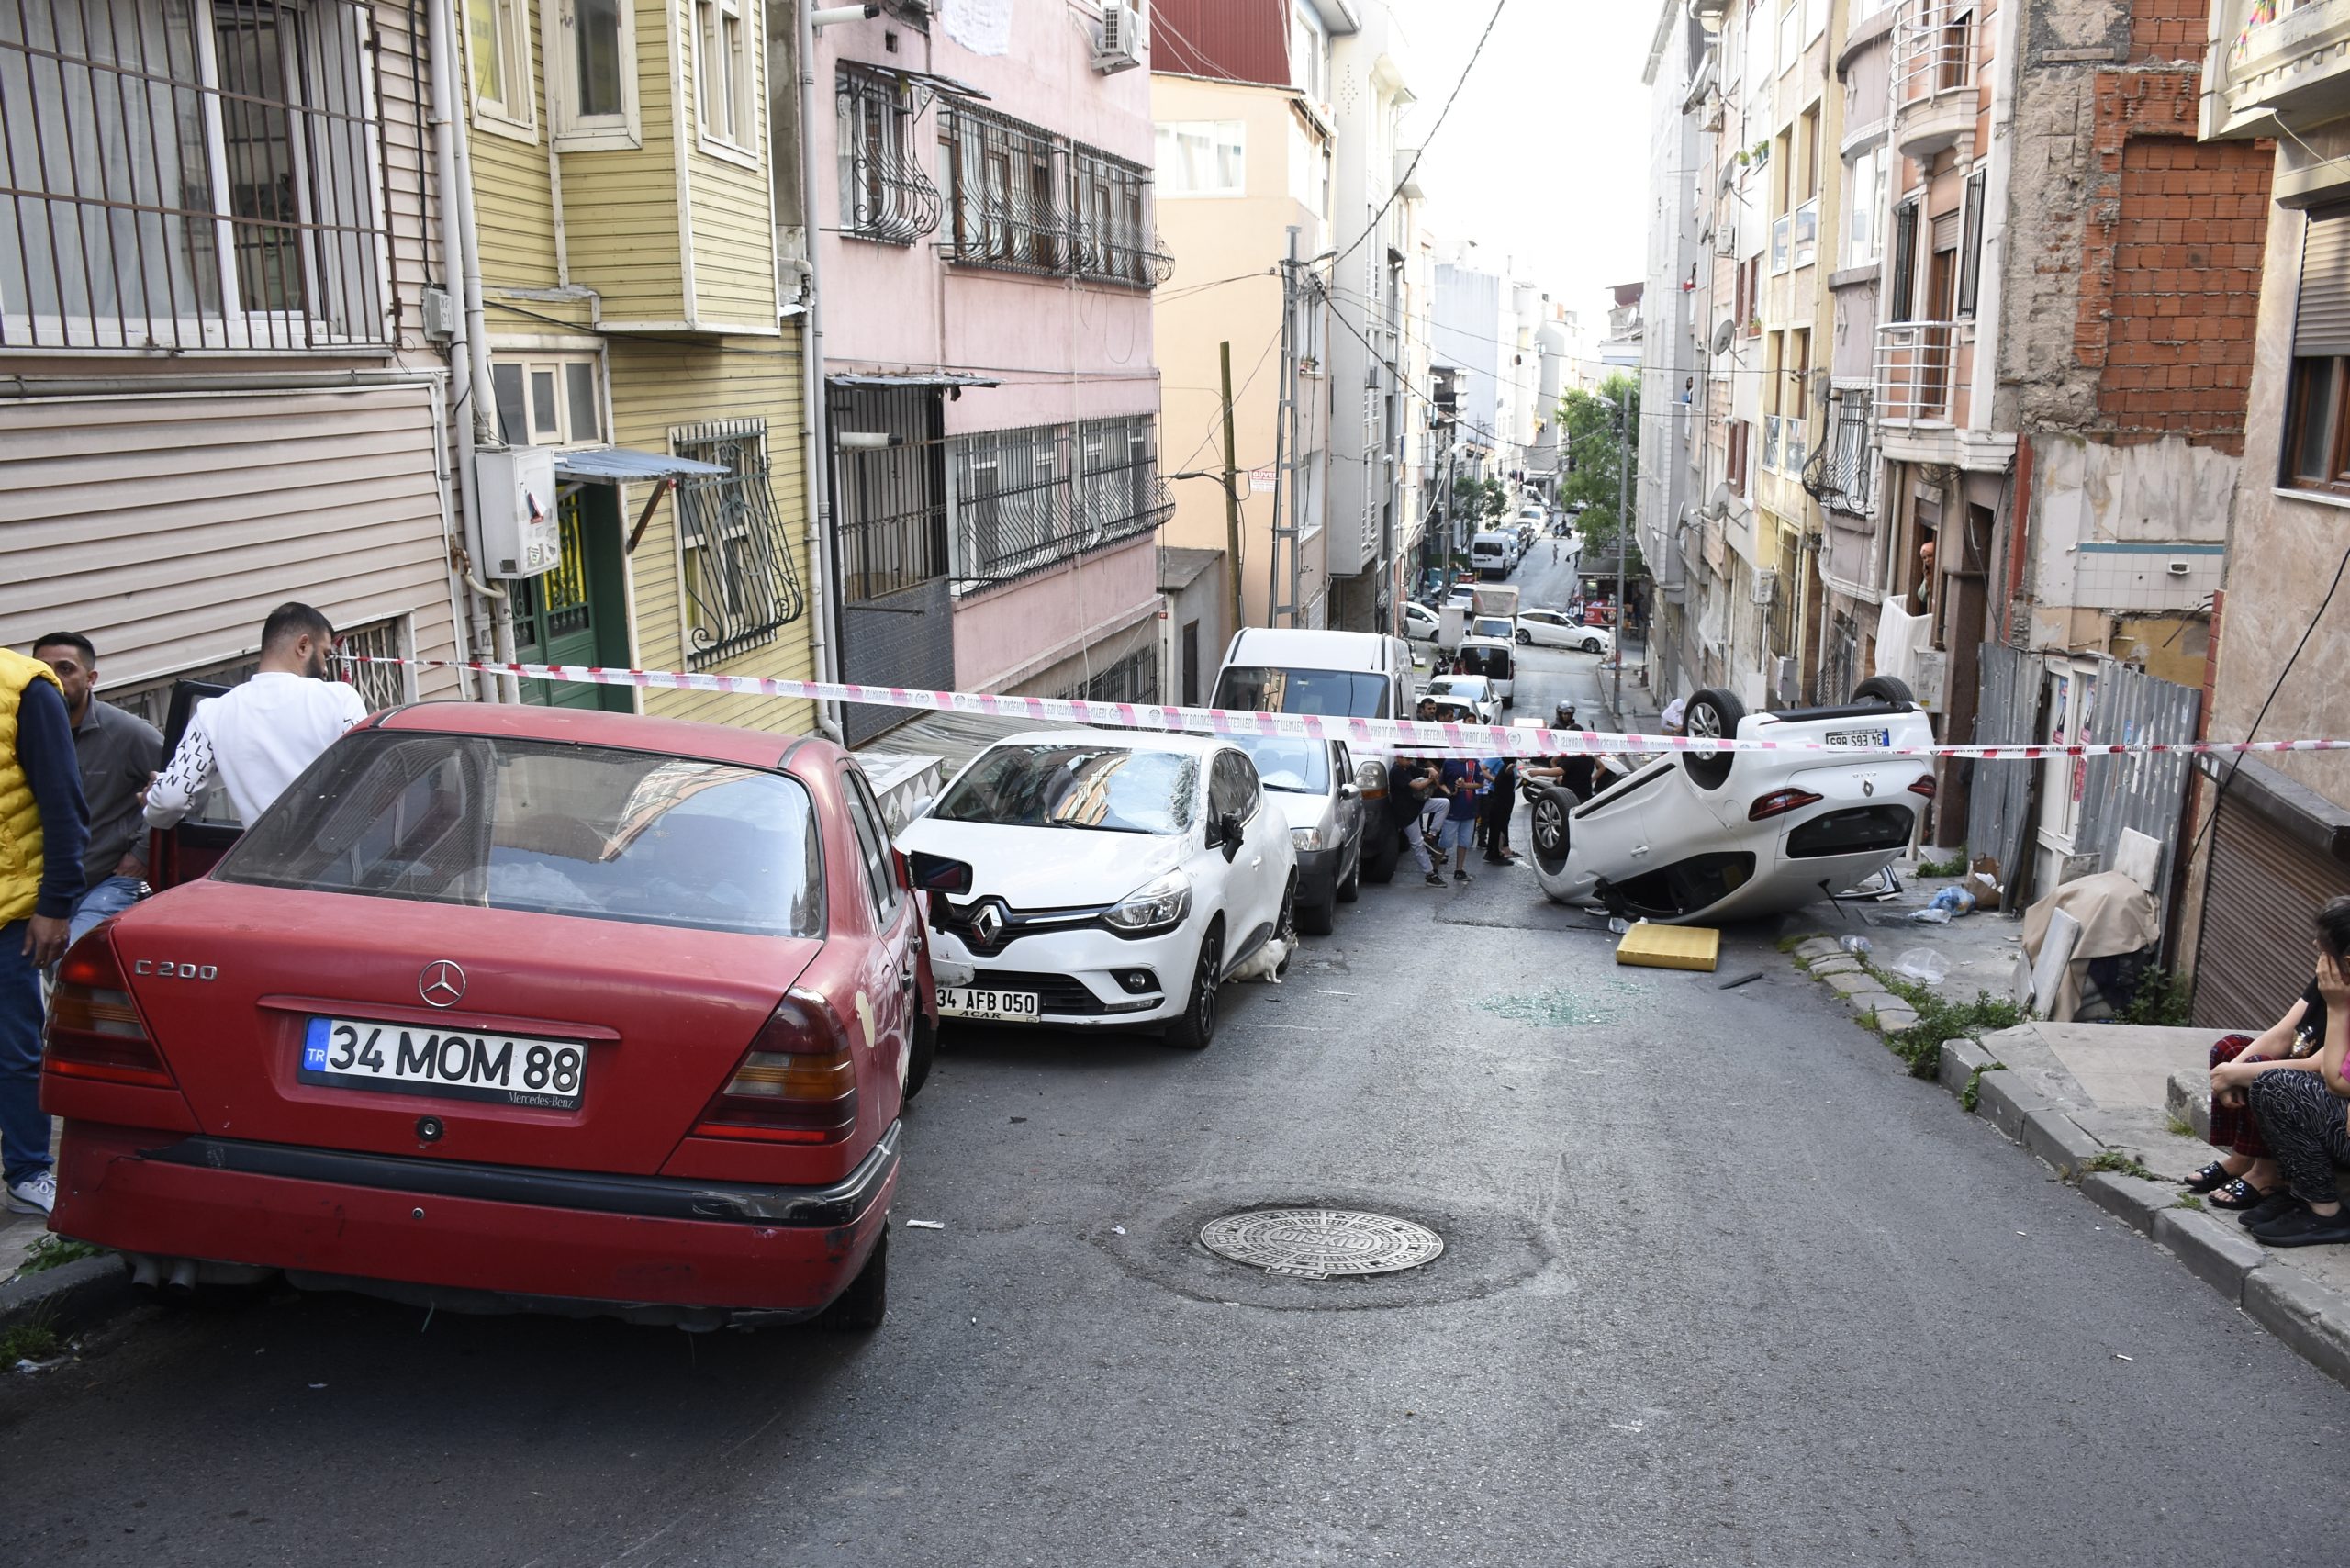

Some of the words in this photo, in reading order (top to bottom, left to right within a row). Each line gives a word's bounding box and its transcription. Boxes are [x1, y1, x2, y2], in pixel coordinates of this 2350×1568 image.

[135, 959, 151, 975] C
[157, 961, 218, 980] 200
[937, 989, 957, 1008] 34
[966, 991, 997, 1011] AFB
[1002, 993, 1035, 1014] 050
[959, 1010, 1002, 1019] ACAR
[308, 1048, 324, 1062] TR
[330, 1025, 384, 1073] 34
[396, 1031, 513, 1087] MOM
[523, 1045, 581, 1092] 88
[507, 1091, 573, 1109] Mercedes-Benz
